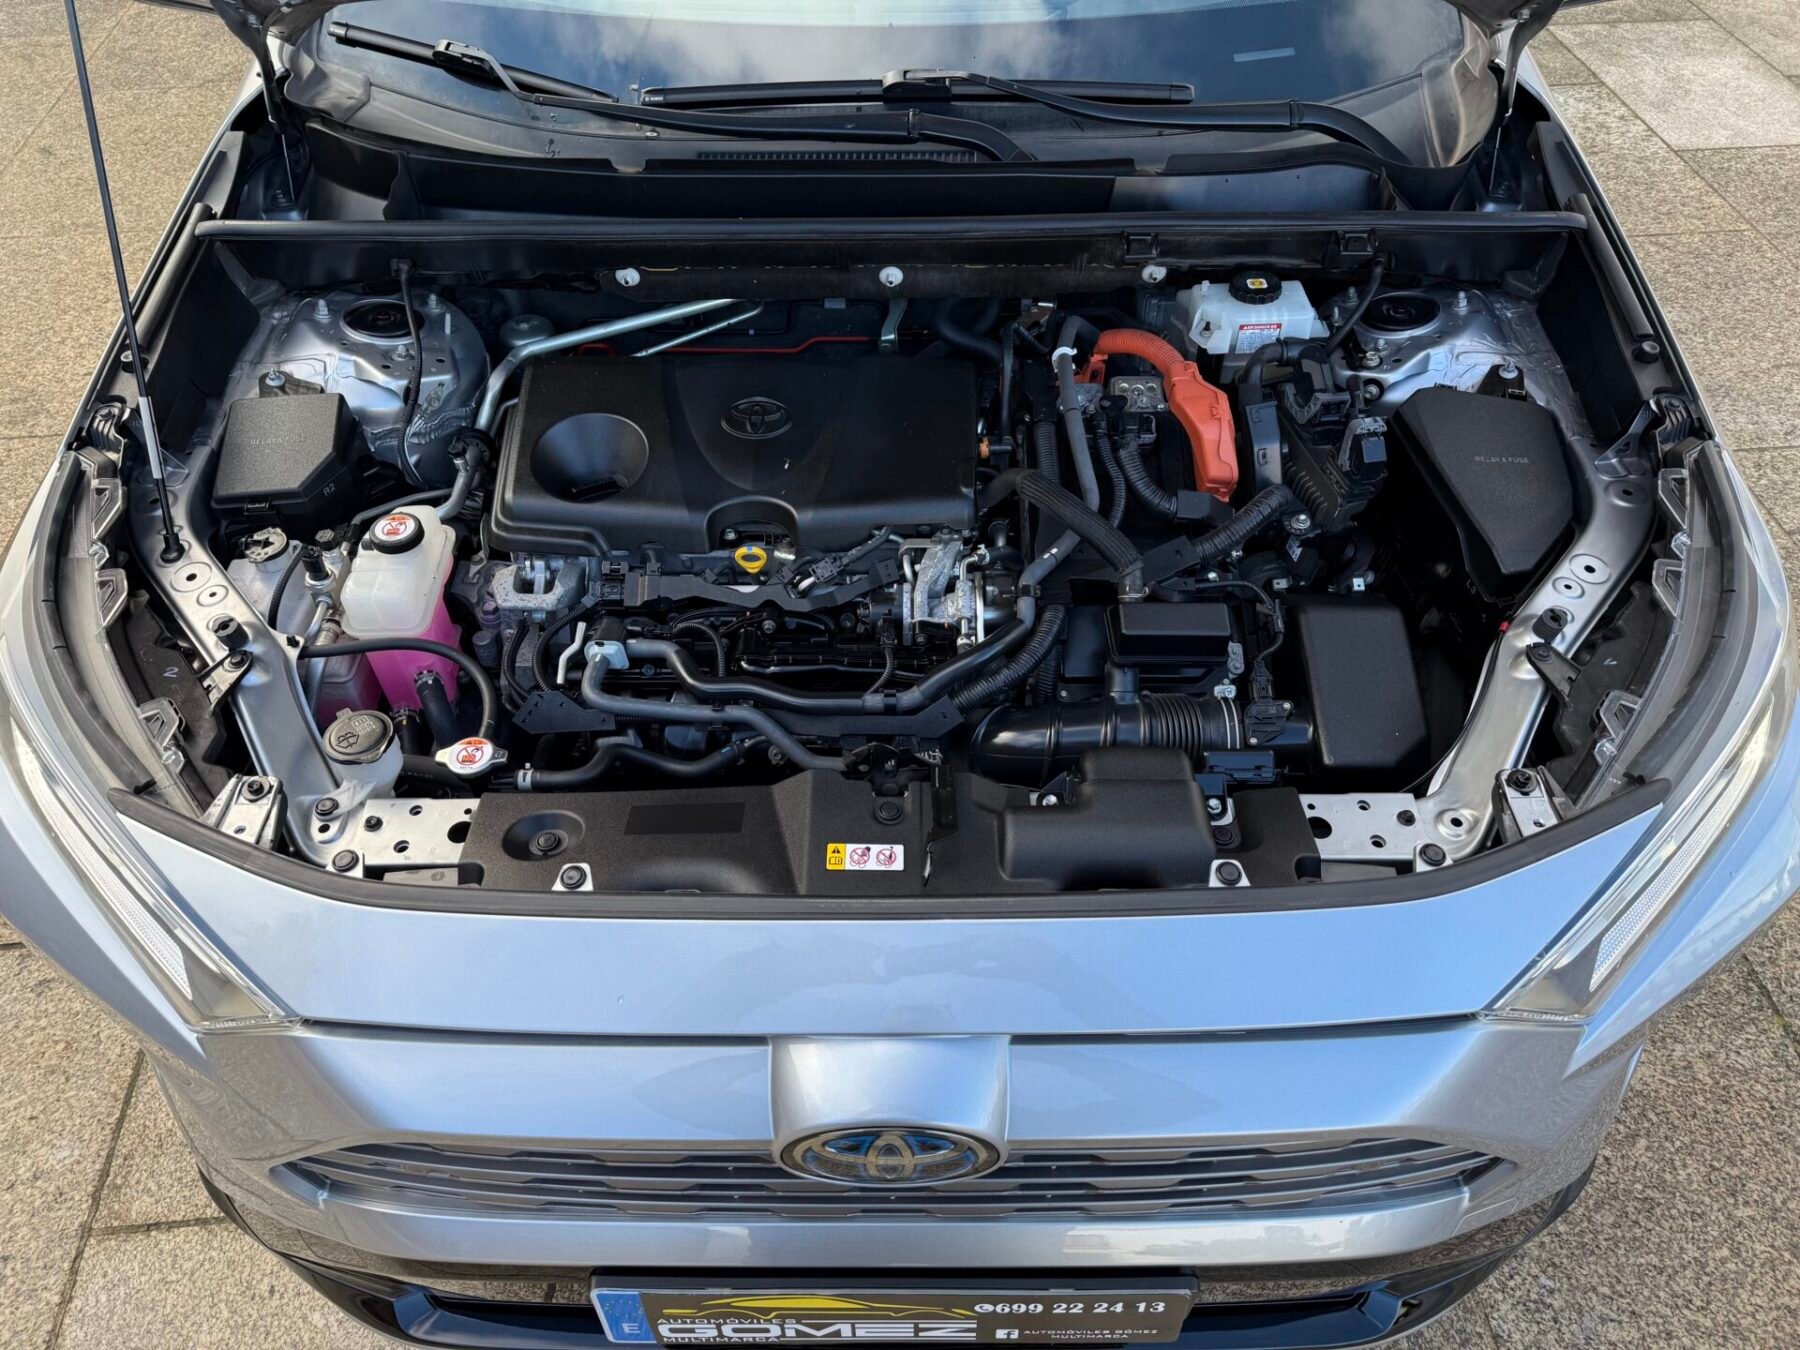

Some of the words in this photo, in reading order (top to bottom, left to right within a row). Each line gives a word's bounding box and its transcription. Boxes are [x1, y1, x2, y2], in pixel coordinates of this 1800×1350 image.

[322, 483, 336, 497] R2
[162, 666, 179, 678] 2
[995, 1303, 1044, 1314] 699
[1052, 1302, 1085, 1313] 22
[1092, 1302, 1124, 1313] 24
[1135, 1302, 1167, 1313] 13
[622, 1323, 641, 1334] E
[657, 1323, 978, 1338] GOMEZ
